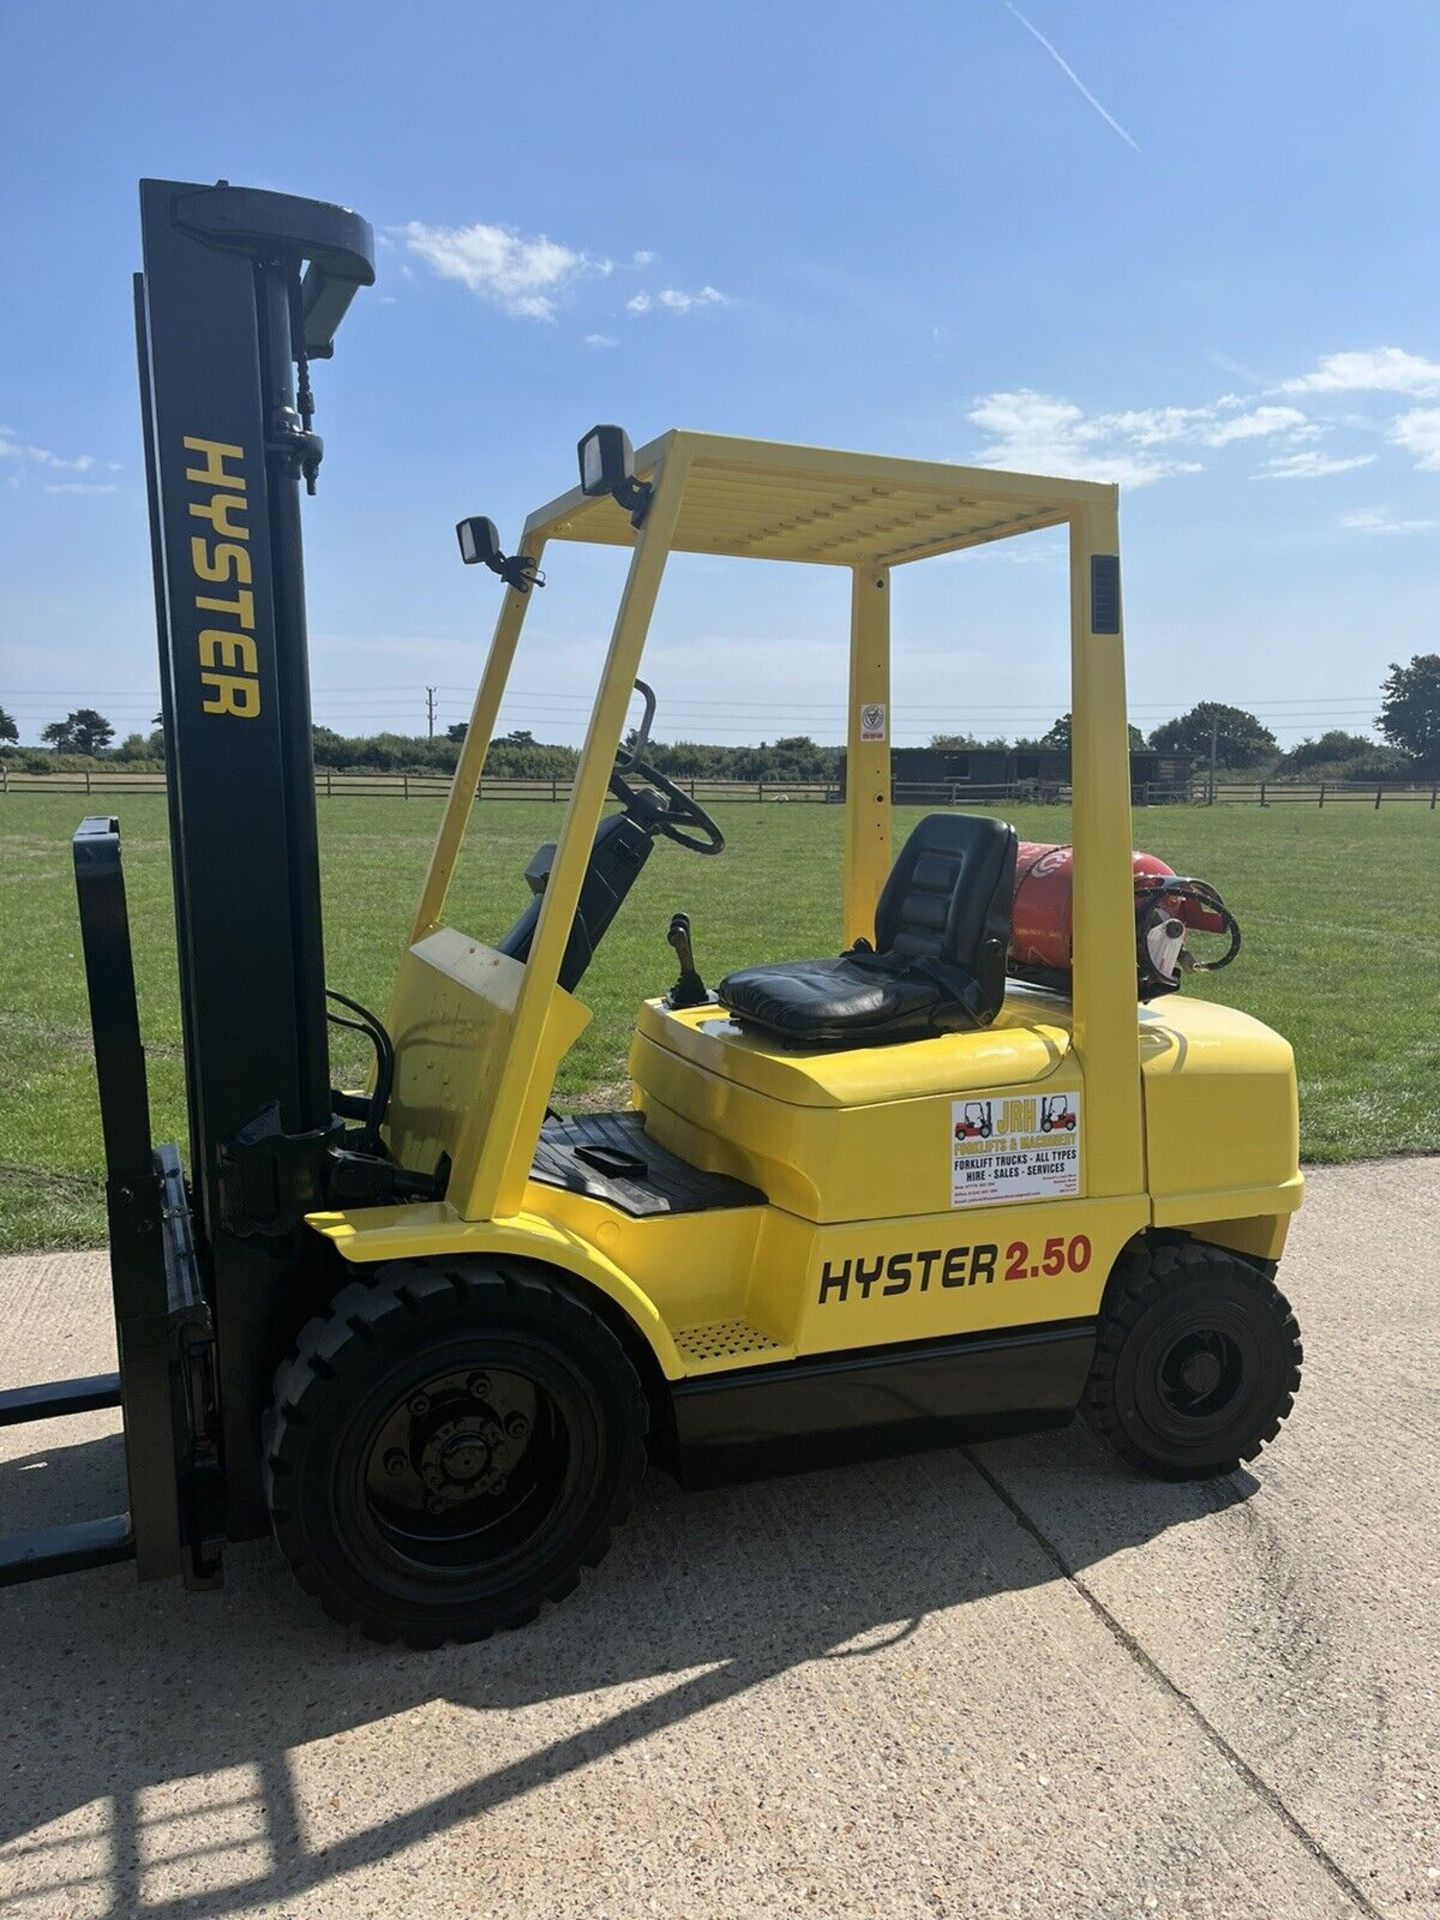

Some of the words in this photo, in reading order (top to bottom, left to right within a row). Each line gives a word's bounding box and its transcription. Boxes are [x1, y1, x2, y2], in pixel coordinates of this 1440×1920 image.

[183, 435, 261, 719] HYSTER
[996, 1098, 1037, 1136] JRH
[954, 1138, 1008, 1157] FORKLIFTS
[1009, 1137, 1018, 1152] &
[1020, 1133, 1077, 1151] MACHINERY
[954, 1158, 993, 1171] FORKLIFT
[996, 1154, 1028, 1167] TRUCKS
[1035, 1152, 1050, 1163] ALL
[1052, 1149, 1077, 1161] TYPES
[966, 1170, 986, 1182] HIRE
[993, 1168, 1020, 1180] SALES
[1026, 1163, 1065, 1176] SERVICES
[817, 1243, 999, 1305] HYSTER
[1004, 1234, 1092, 1281] 2.50
